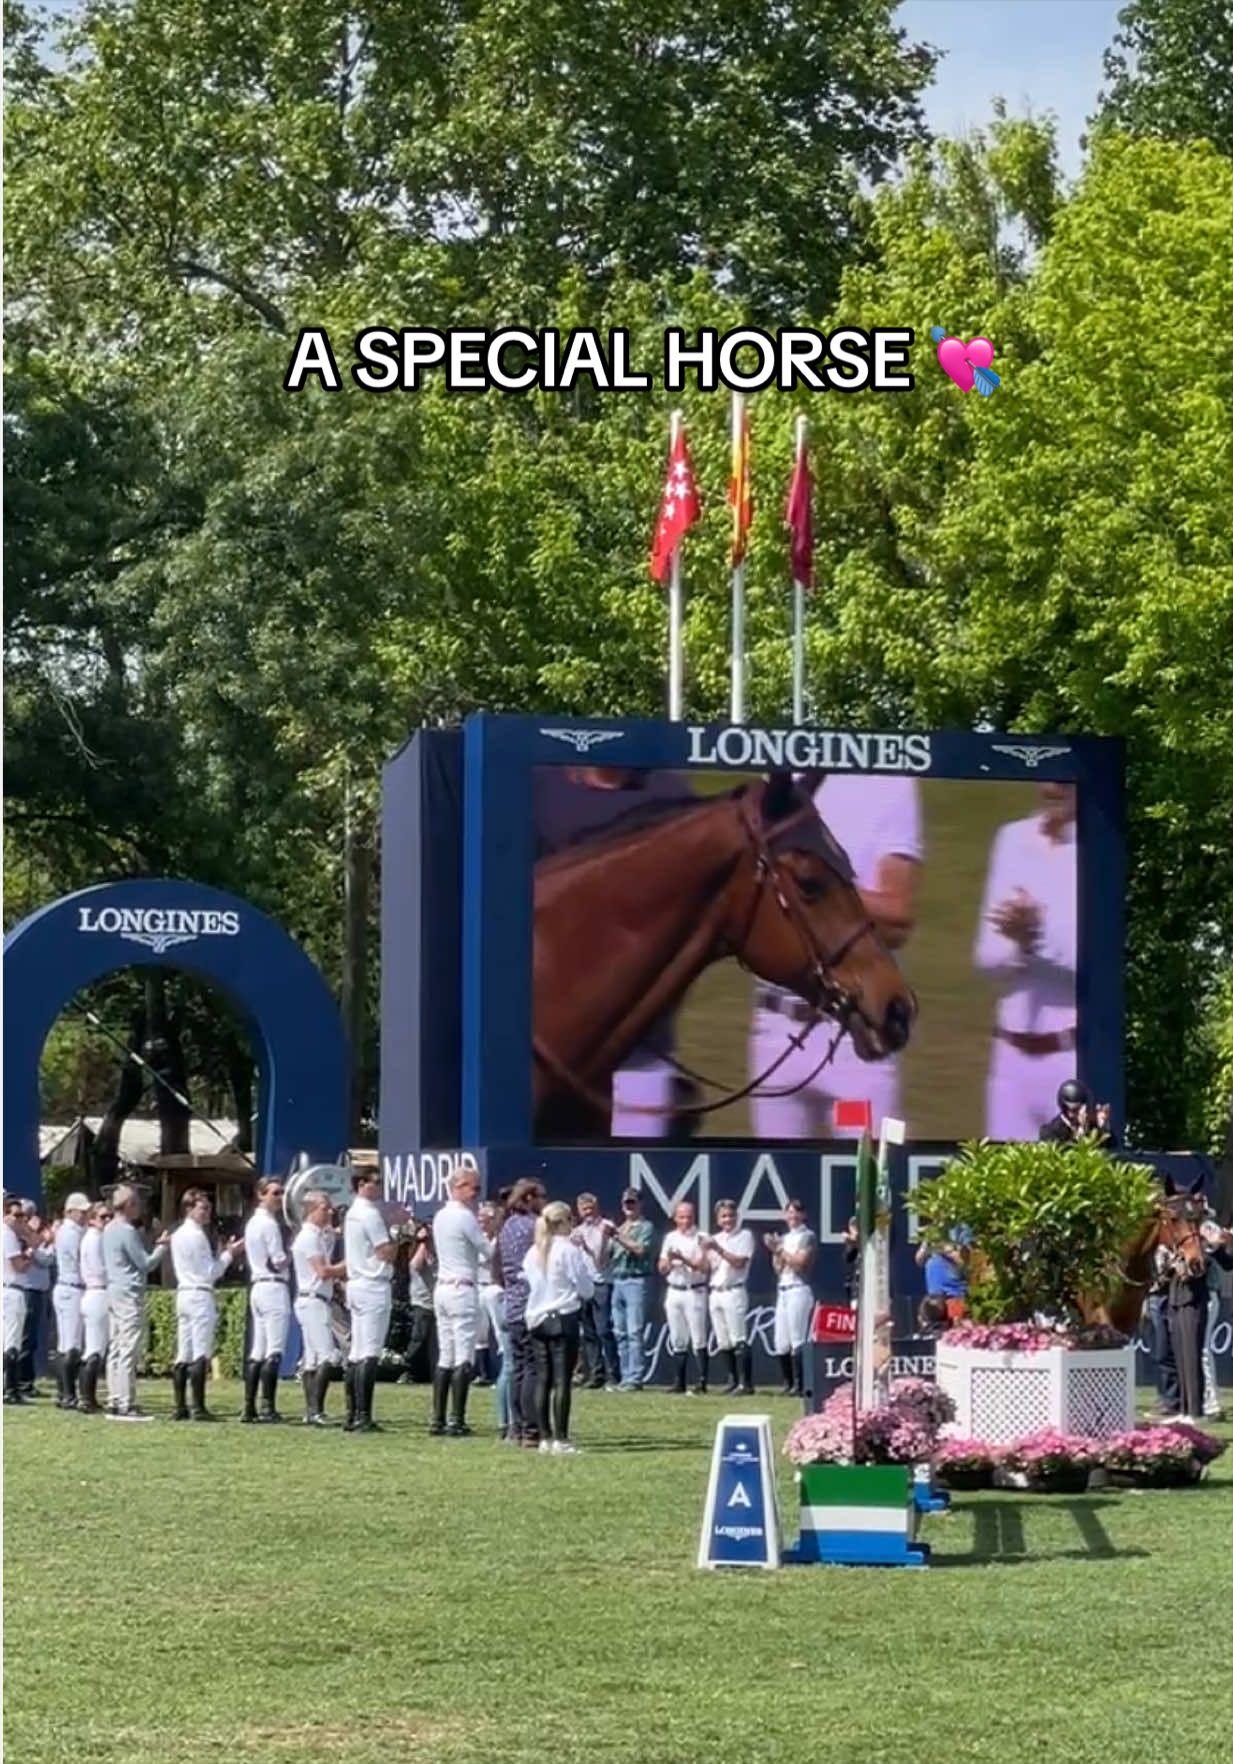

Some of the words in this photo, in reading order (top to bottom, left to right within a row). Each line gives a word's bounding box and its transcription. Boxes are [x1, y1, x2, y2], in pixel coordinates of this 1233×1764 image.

[687, 726, 933, 771] LONGINES
[78, 907, 240, 935] LONGINES
[727, 1481, 752, 1508] A
